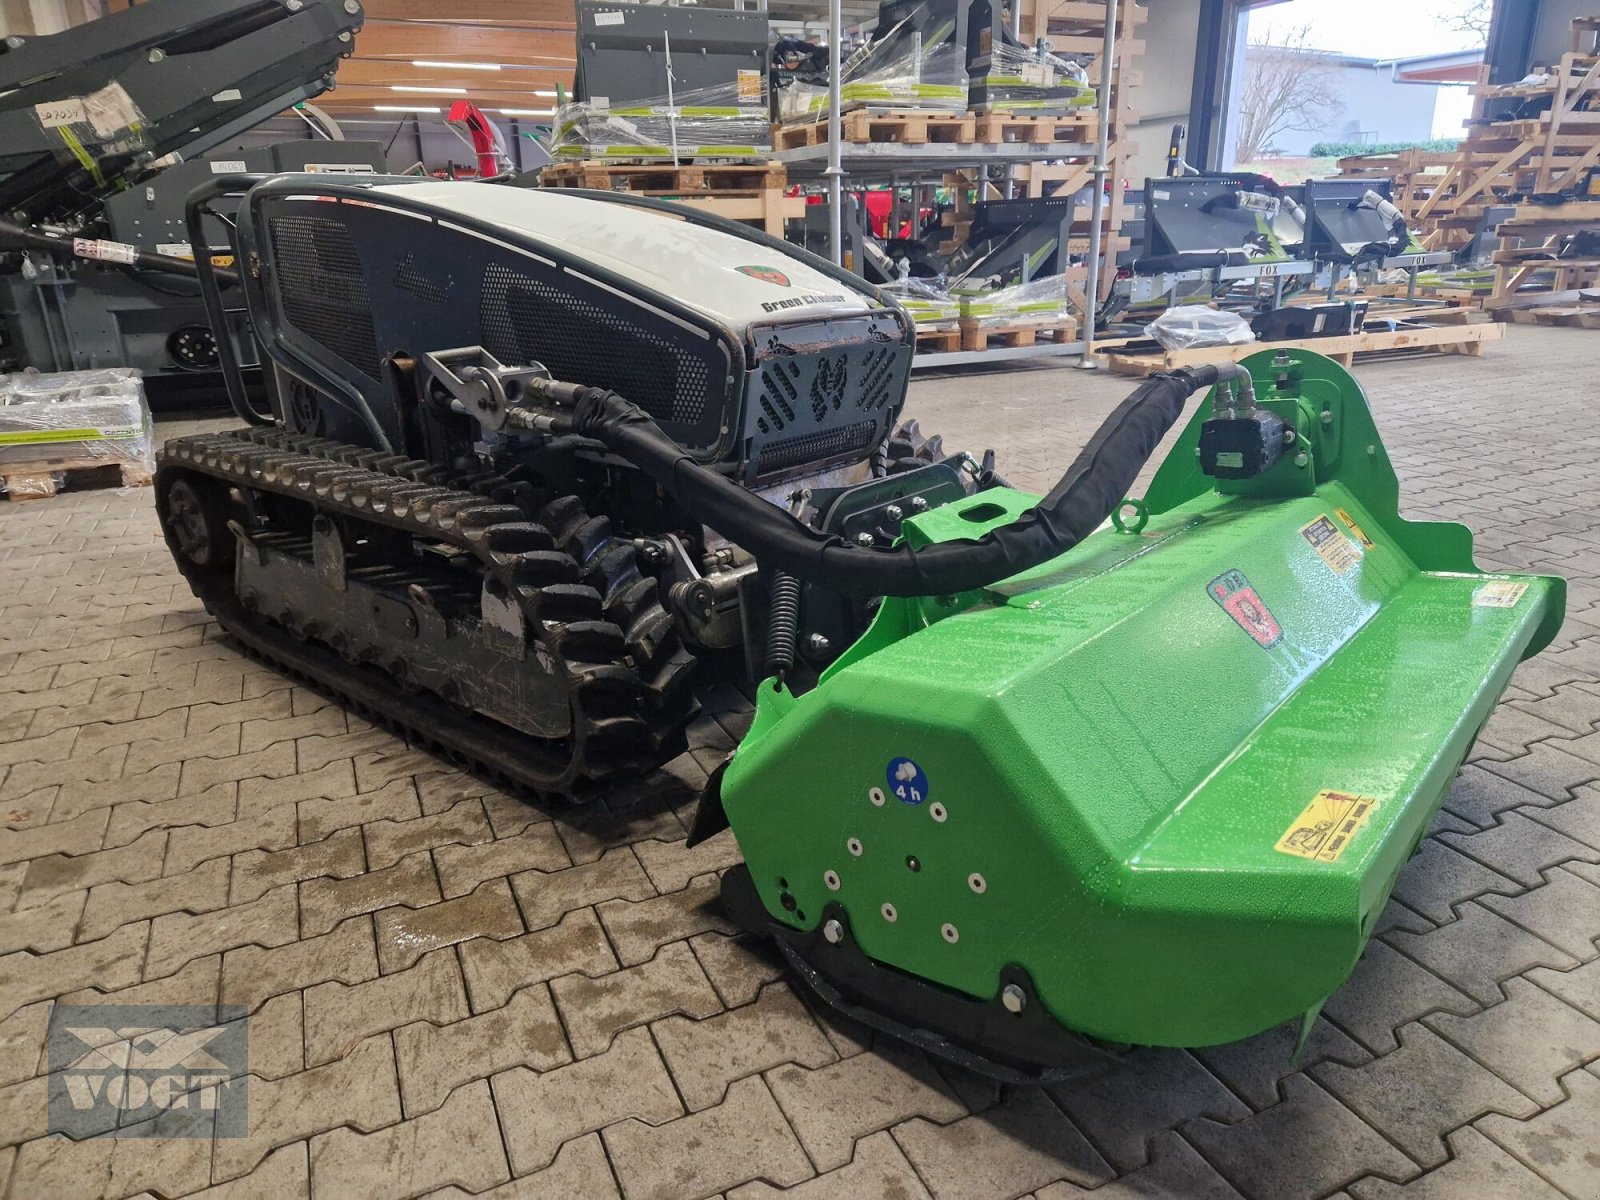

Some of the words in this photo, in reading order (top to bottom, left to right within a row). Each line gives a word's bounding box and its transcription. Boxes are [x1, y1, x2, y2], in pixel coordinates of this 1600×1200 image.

[1411, 256, 1426, 266] FOX
[1260, 264, 1279, 276] FOX
[761, 298, 804, 313] Green
[801, 294, 846, 305] Climber
[896, 785, 907, 799] 4
[910, 787, 921, 801] h
